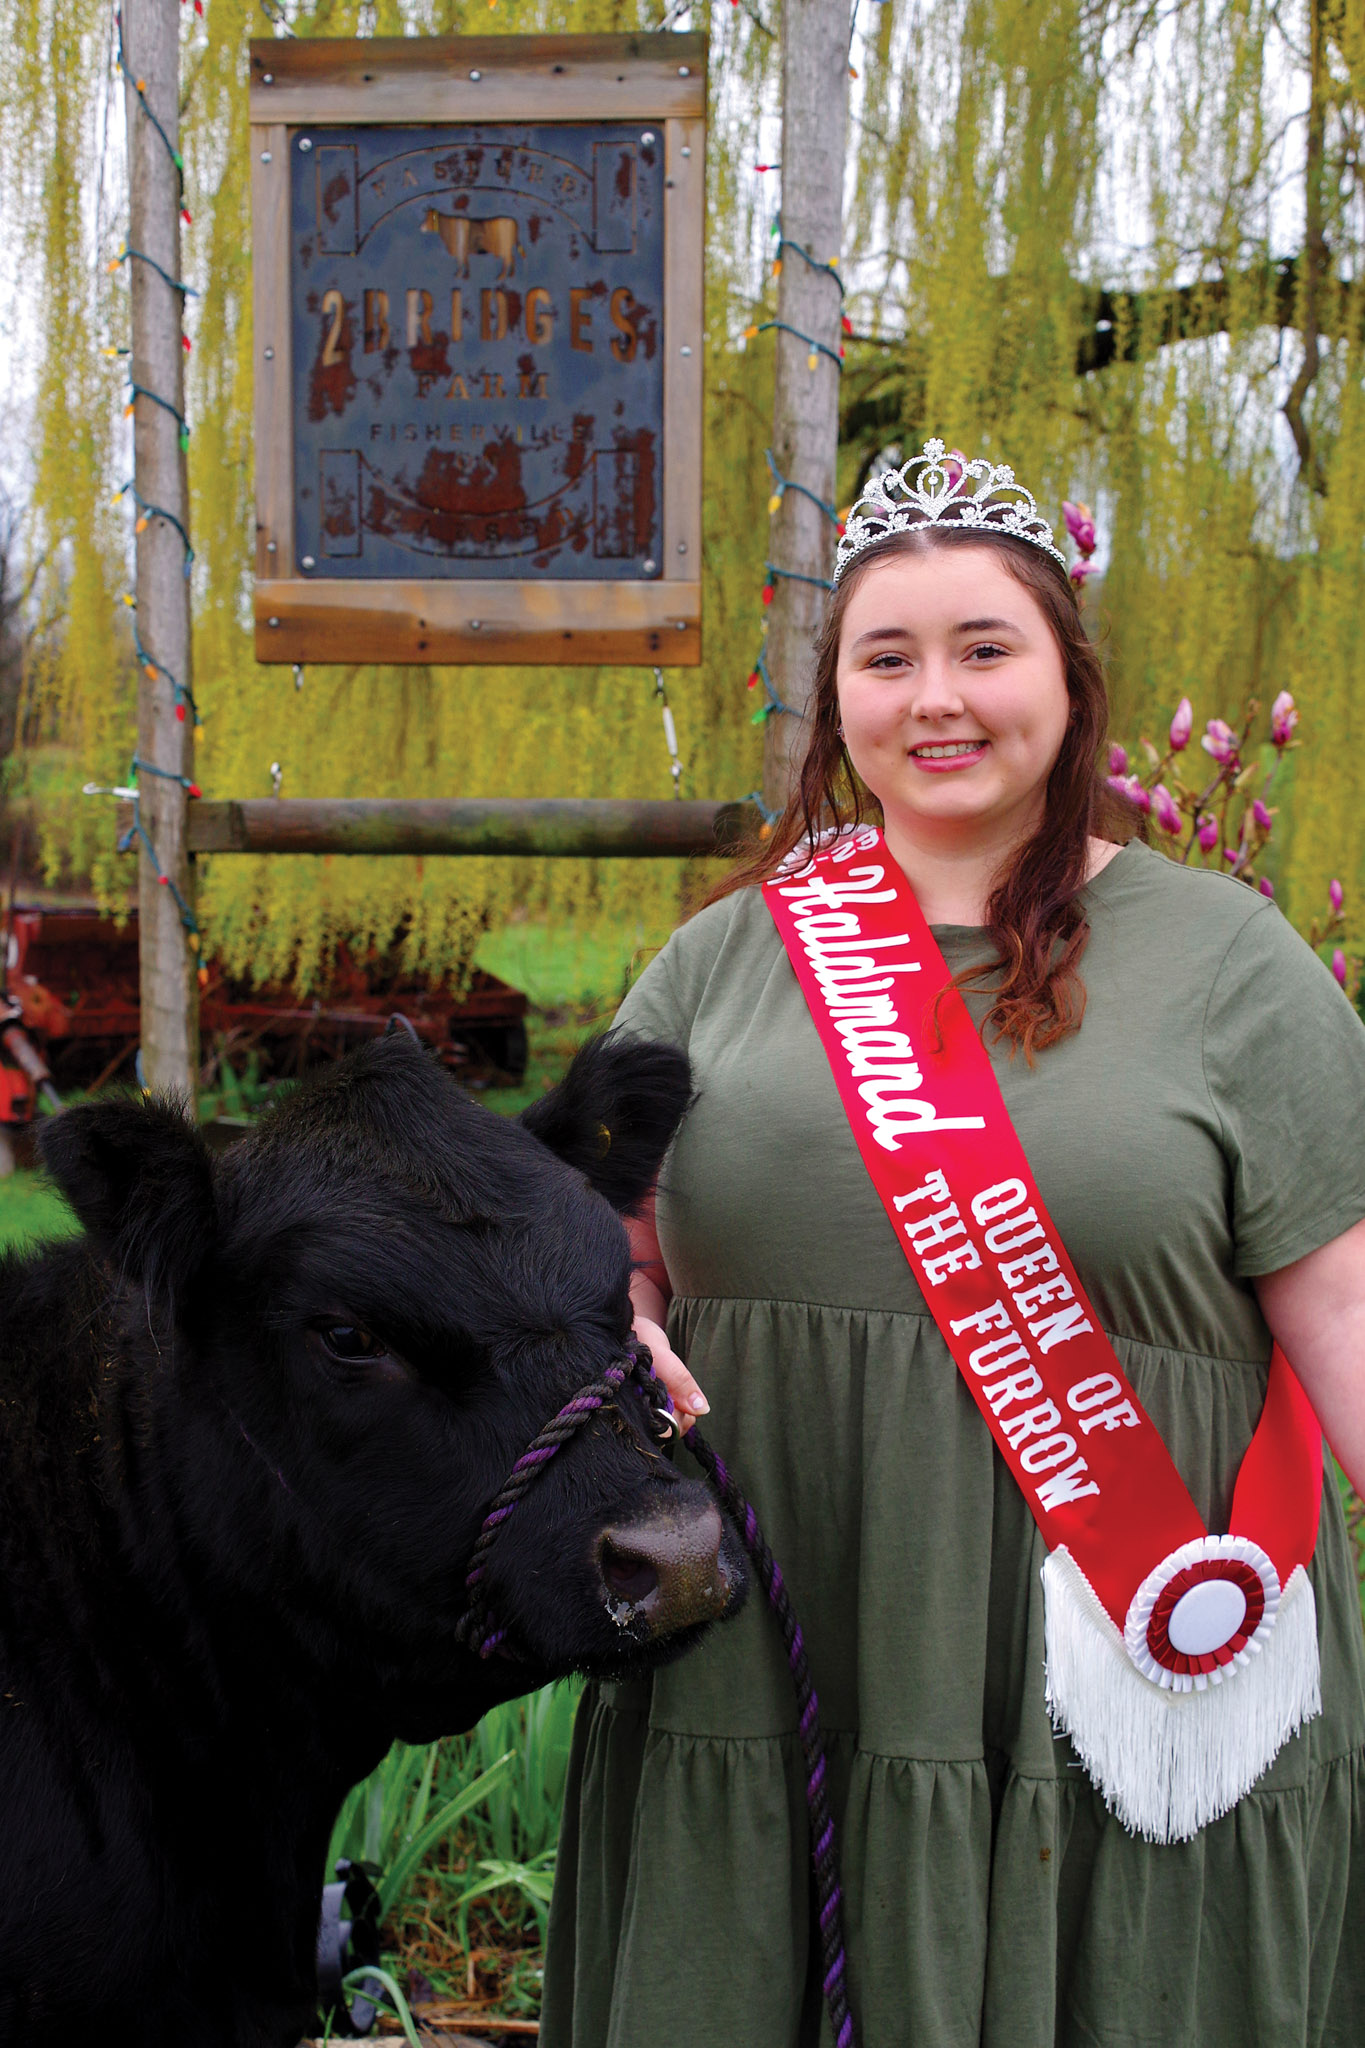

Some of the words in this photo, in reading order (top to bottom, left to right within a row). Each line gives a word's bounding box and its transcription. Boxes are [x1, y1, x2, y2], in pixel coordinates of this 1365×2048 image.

[416, 372, 550, 400] FARM
[778, 864, 987, 1152] Haldimand
[892, 1168, 983, 1287] THE
[949, 1299, 1101, 1513] FURROW
[970, 1177, 1094, 1355] QUEEN
[1066, 1371, 1142, 1436] OF
